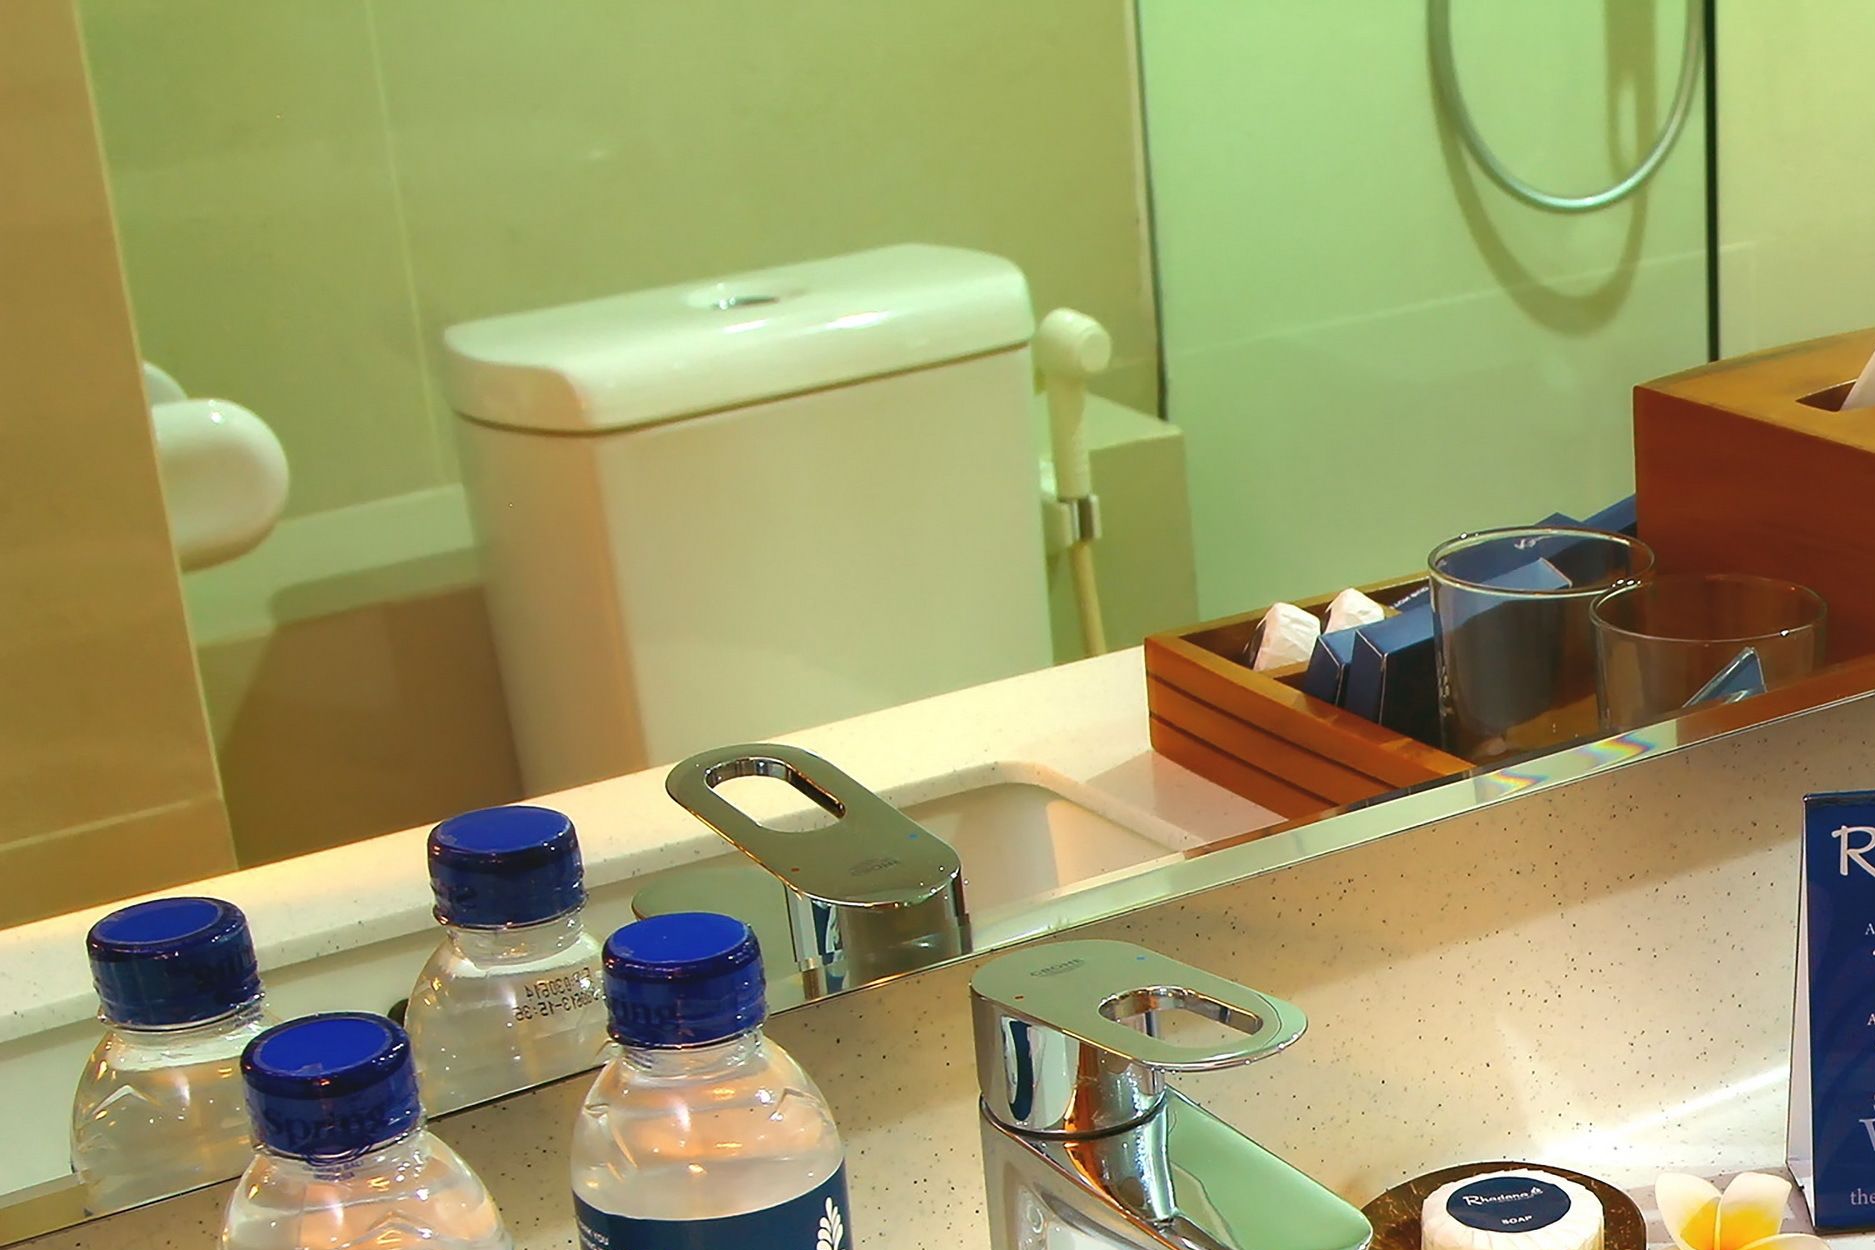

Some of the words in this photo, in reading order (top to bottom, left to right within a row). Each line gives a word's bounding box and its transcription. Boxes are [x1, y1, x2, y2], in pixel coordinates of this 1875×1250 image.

[1865, 923, 1875, 935] A
[1463, 1192, 1529, 1206] Rhadana
[1501, 1215, 1533, 1225] SOAP
